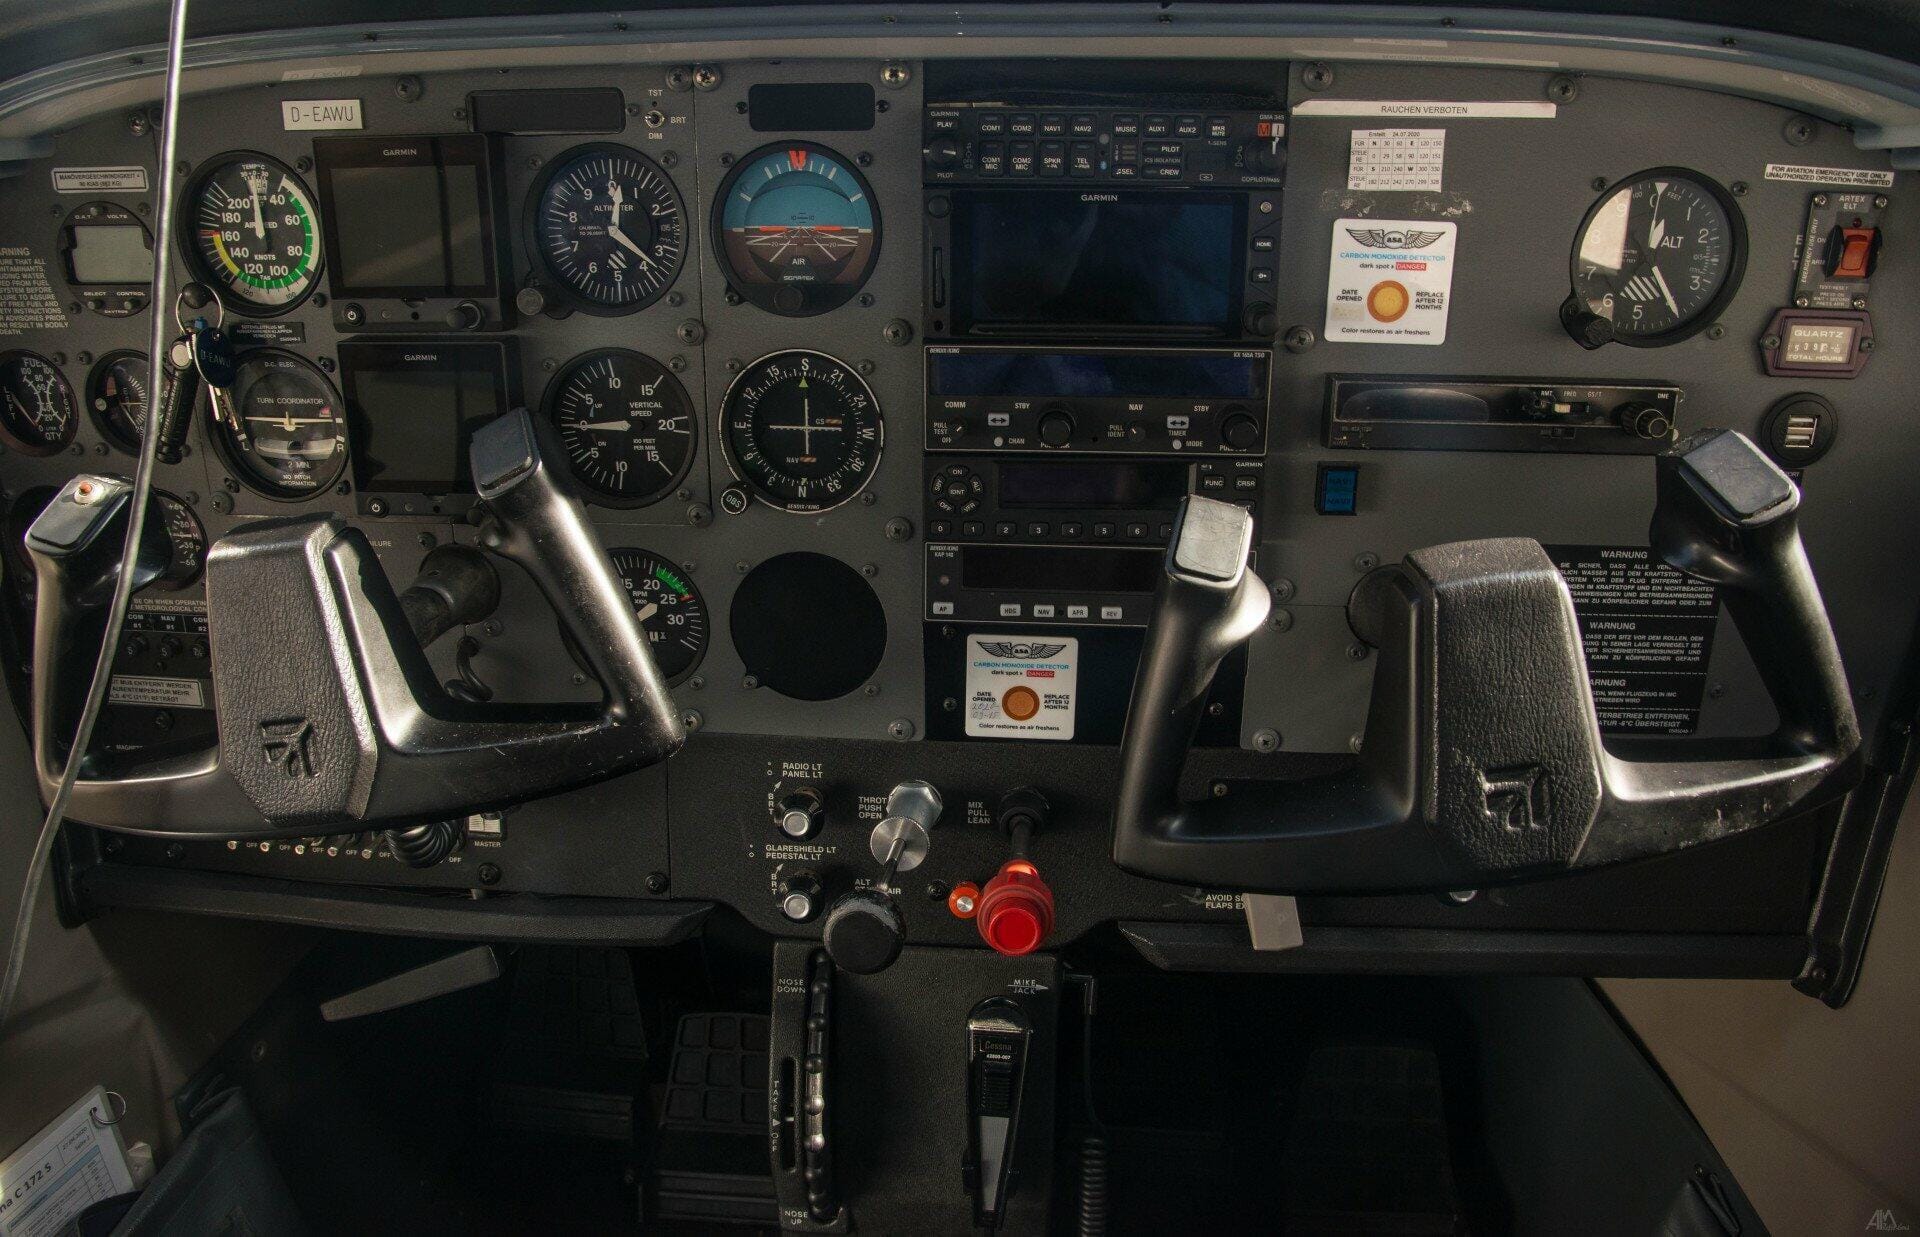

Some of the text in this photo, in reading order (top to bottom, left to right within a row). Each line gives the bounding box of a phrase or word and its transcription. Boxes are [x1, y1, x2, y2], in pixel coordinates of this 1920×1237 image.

[292, 106, 353, 122] D-EAWU
[1423, 106, 1468, 114] VERBOTEN
[1766, 172, 1814, 180] UNAUTHORIZED
[1816, 168, 1854, 176] EMERGENCY
[270, 194, 285, 205] 40
[584, 189, 593, 200] 9
[227, 198, 250, 209] 200
[652, 204, 661, 216] 2
[222, 213, 241, 223] 180
[285, 215, 300, 225] 60
[569, 211, 577, 223] 8
[221, 231, 240, 241] 160
[1698, 228, 1709, 243] 2
[571, 241, 579, 252] 7
[1661, 236, 1684, 248] ALT
[230, 248, 249, 258] 140
[287, 246, 303, 256] 80
[655, 245, 663, 257] 3
[792, 258, 805, 266] AIR
[244, 264, 263, 274] 120
[270, 265, 288, 276] 100
[589, 262, 597, 273] 6
[614, 270, 622, 282] 5
[1690, 276, 1700, 291] 3
[1632, 305, 1643, 319] 5
[1794, 330, 1843, 338] QUARTZ
[767, 365, 779, 378] 15
[830, 369, 844, 382] 21
[609, 378, 620, 388] 10
[641, 385, 653, 396] 15
[585, 394, 593, 405] 5
[945, 401, 966, 409] COMM
[658, 420, 675, 430] 20
[647, 451, 659, 461] 15
[615, 461, 627, 472] 10
[1601, 551, 1647, 559] WARNUNG
[643, 580, 660, 590] 20
[660, 594, 677, 605] 25
[667, 614, 684, 625] 30
[1590, 621, 1636, 630] WARNUNG
[782, 762, 822, 771] RADIO LT
[782, 770, 811, 778] PANEL
[858, 804, 882, 812] PUSH
[968, 809, 989, 817] PULL
[766, 845, 836, 854] GLARESHIELD LT
[809, 853, 821, 861] LT
[778, 978, 804, 986] NOSE
[1013, 987, 1035, 995] JACK
[15, 1162, 52, 1199] C 172 S
